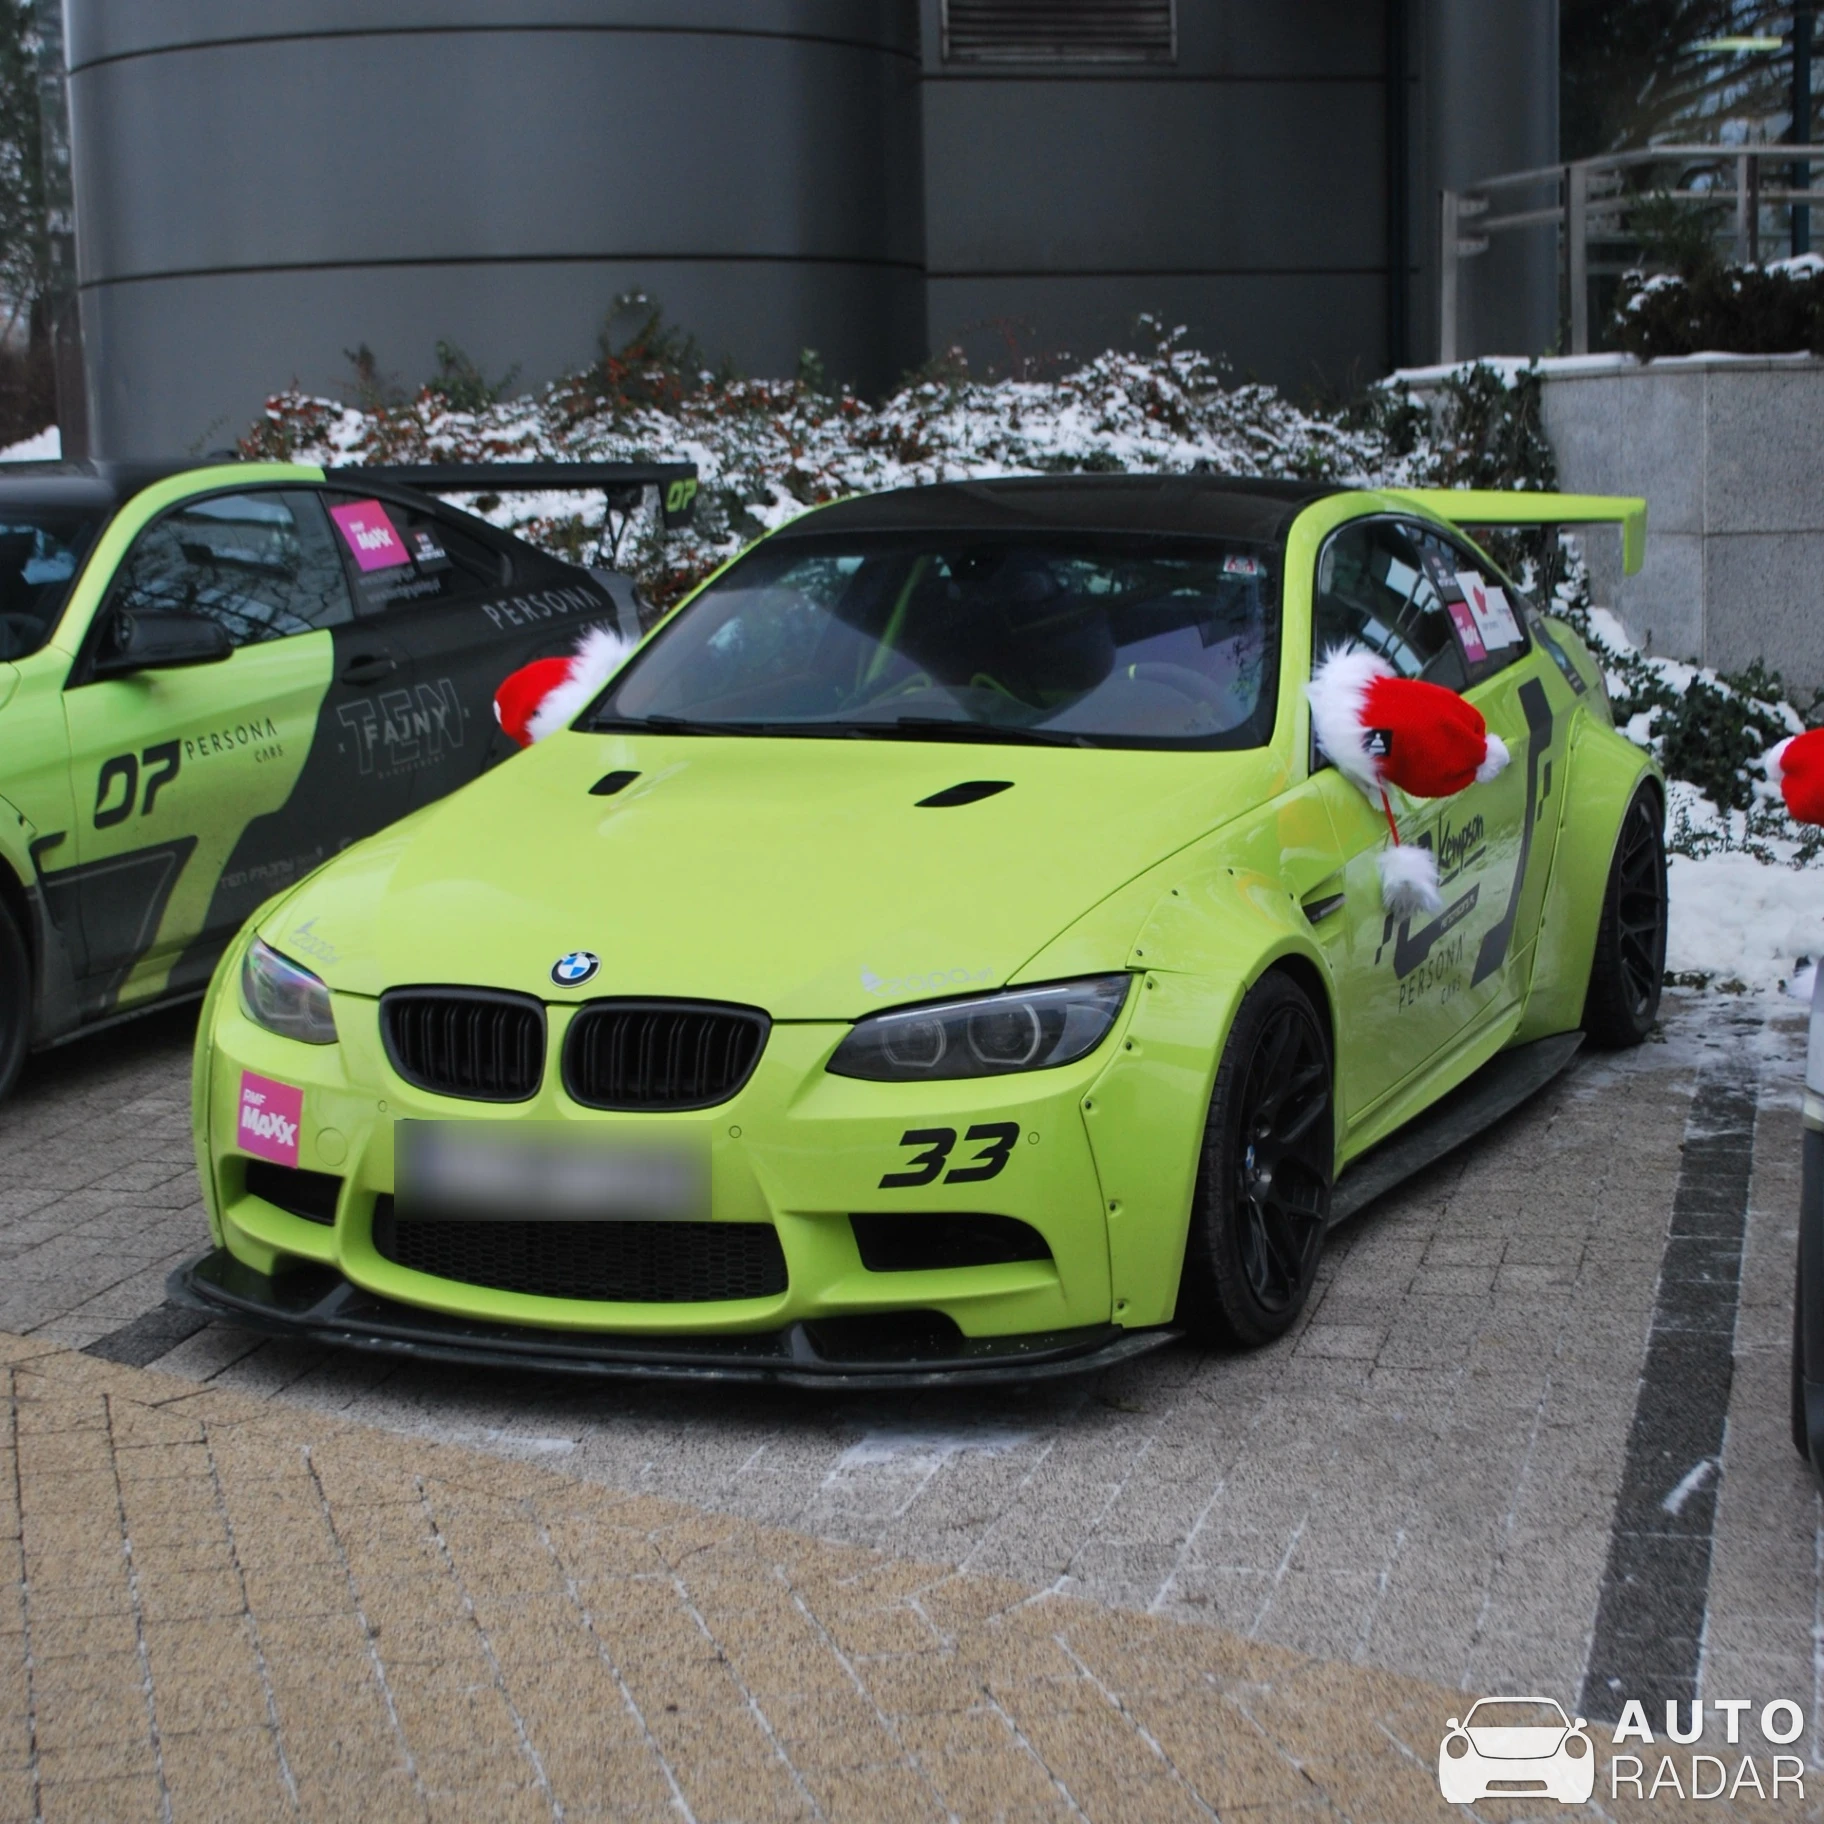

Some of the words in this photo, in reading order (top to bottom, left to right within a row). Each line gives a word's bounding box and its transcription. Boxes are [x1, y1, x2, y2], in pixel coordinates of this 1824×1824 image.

[666, 478, 697, 512] 07
[481, 585, 603, 630] PERSONA
[184, 717, 277, 761] PERSONA
[336, 677, 464, 776] TEN
[364, 706, 447, 749] FAJNY
[254, 744, 284, 764] CARS
[93, 738, 181, 830] 07
[1398, 932, 1463, 1014] PERSONA
[242, 1088, 267, 1106] RMF
[877, 1121, 1020, 1189] 33
